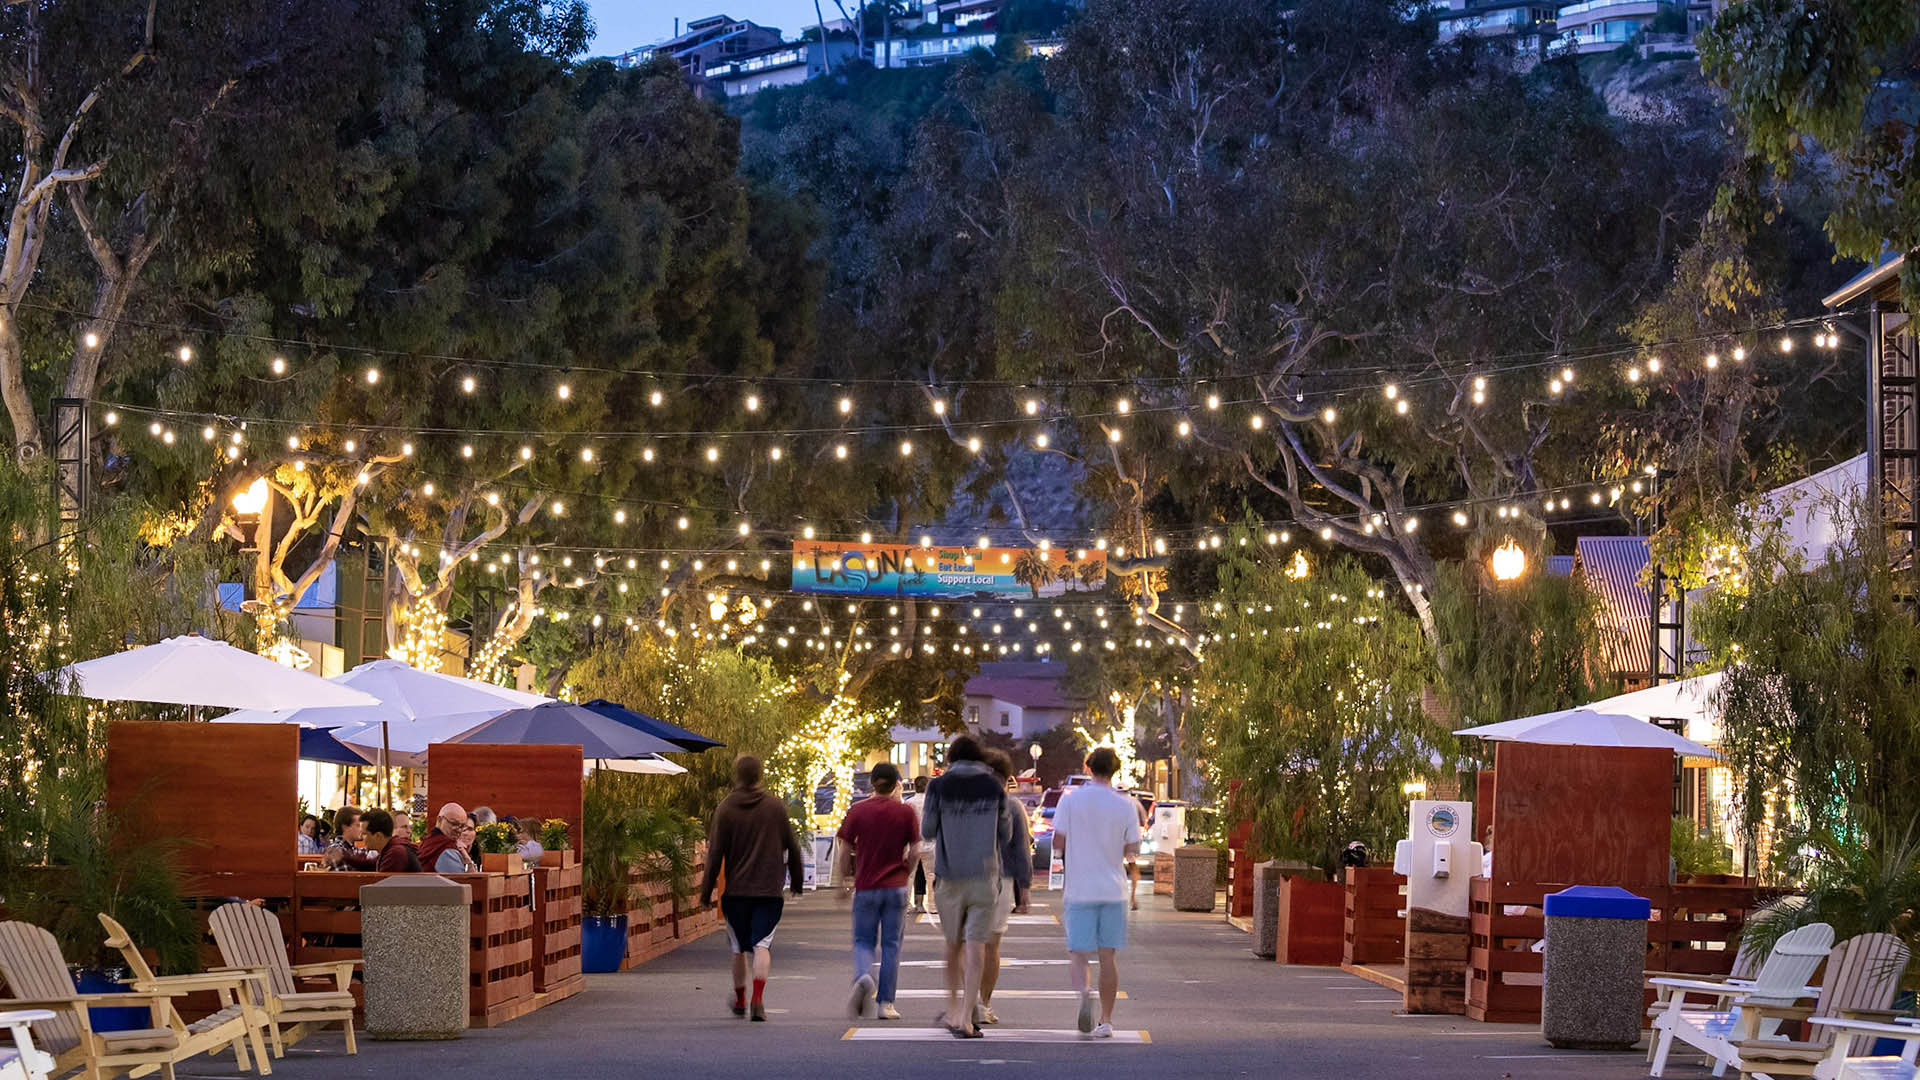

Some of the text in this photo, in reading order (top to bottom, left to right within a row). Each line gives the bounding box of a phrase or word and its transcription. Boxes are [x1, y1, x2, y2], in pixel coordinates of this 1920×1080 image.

[938, 550, 959, 561] Shop
[937, 573, 971, 585] Support
[972, 573, 994, 584] Local
